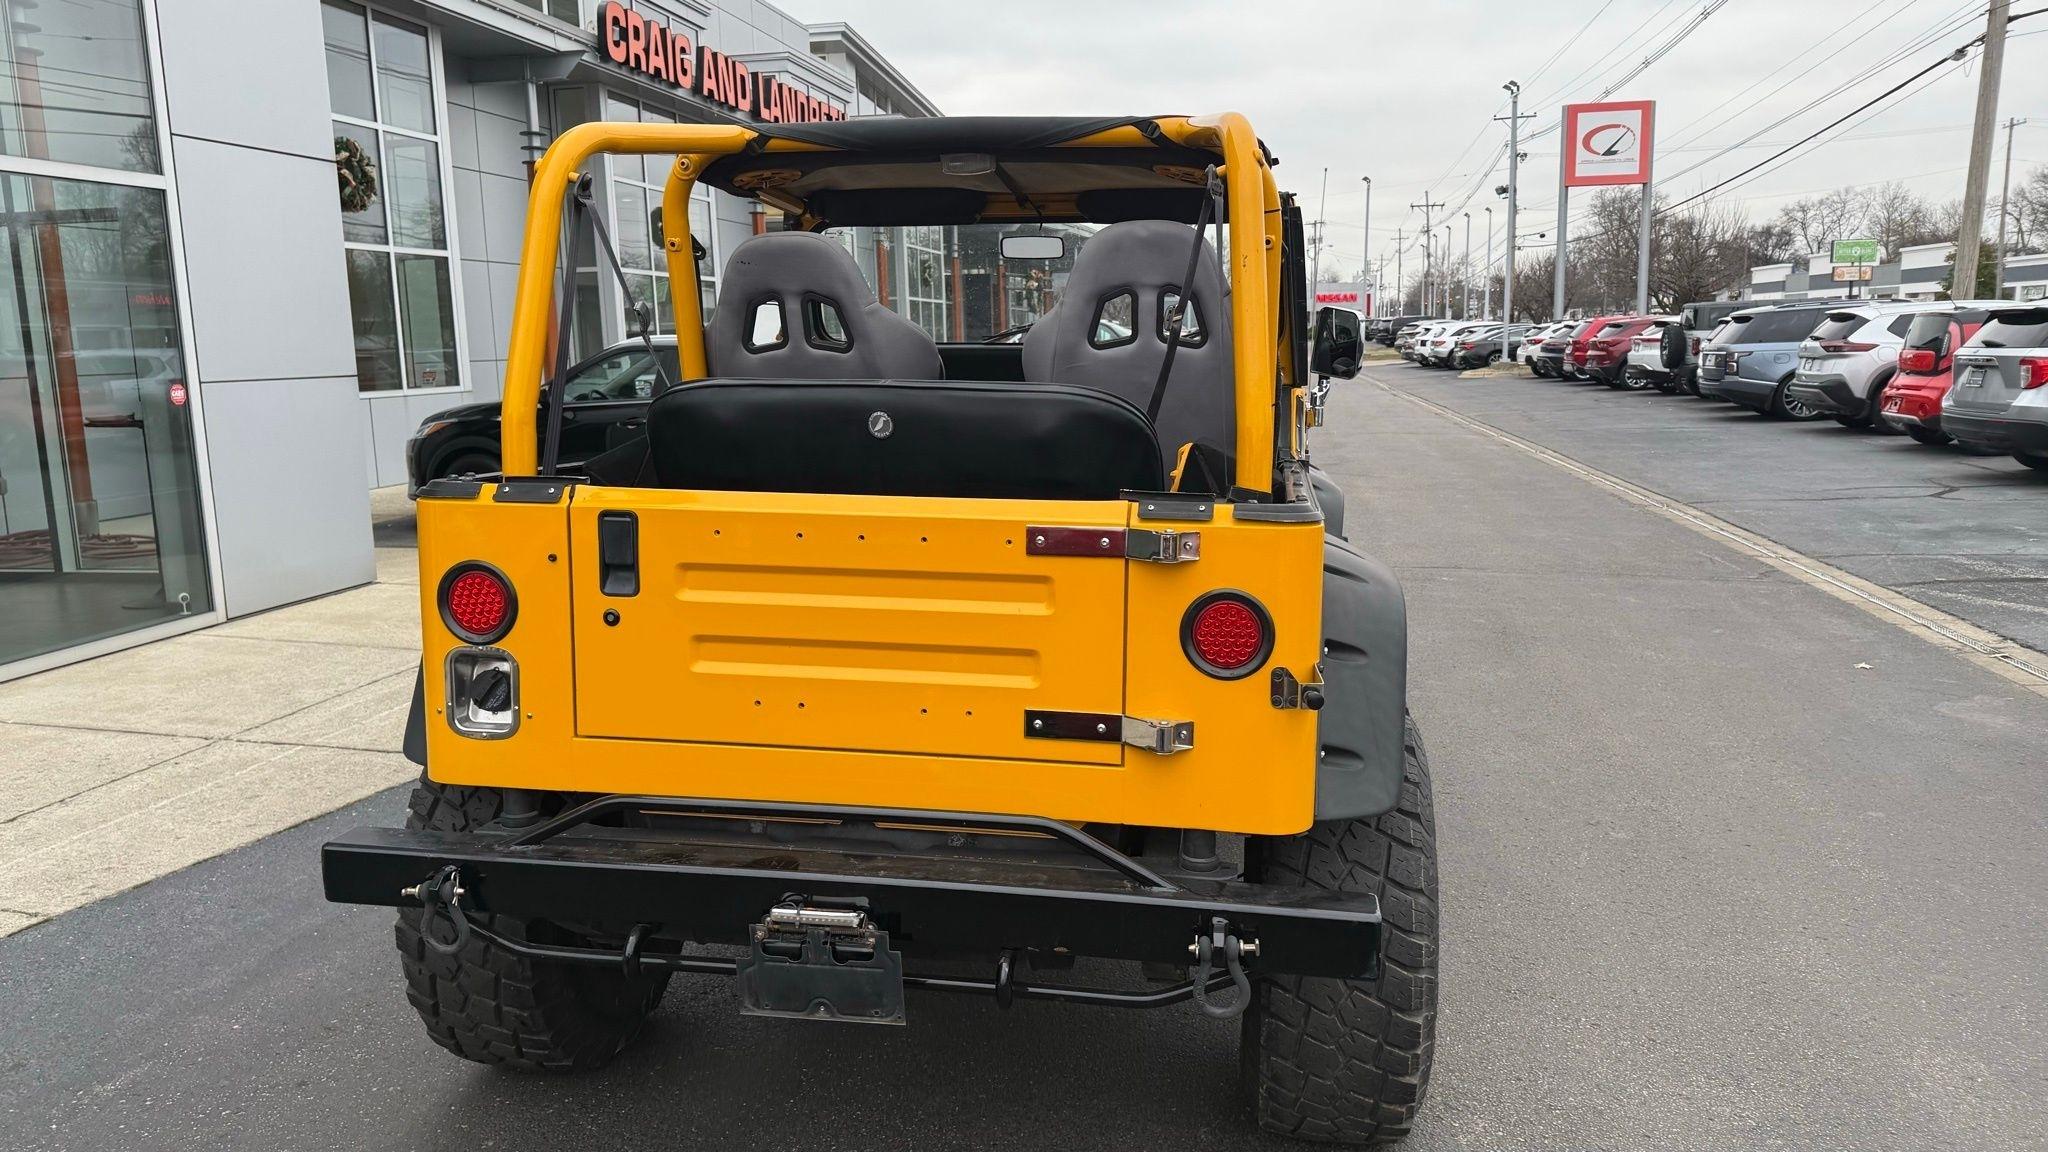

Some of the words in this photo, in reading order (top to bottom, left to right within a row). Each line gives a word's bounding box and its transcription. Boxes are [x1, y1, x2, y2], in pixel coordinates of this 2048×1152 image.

[603, 0, 693, 89] CRAIG
[701, 46, 751, 112] AND
[1316, 293, 1358, 303] NISSAN
